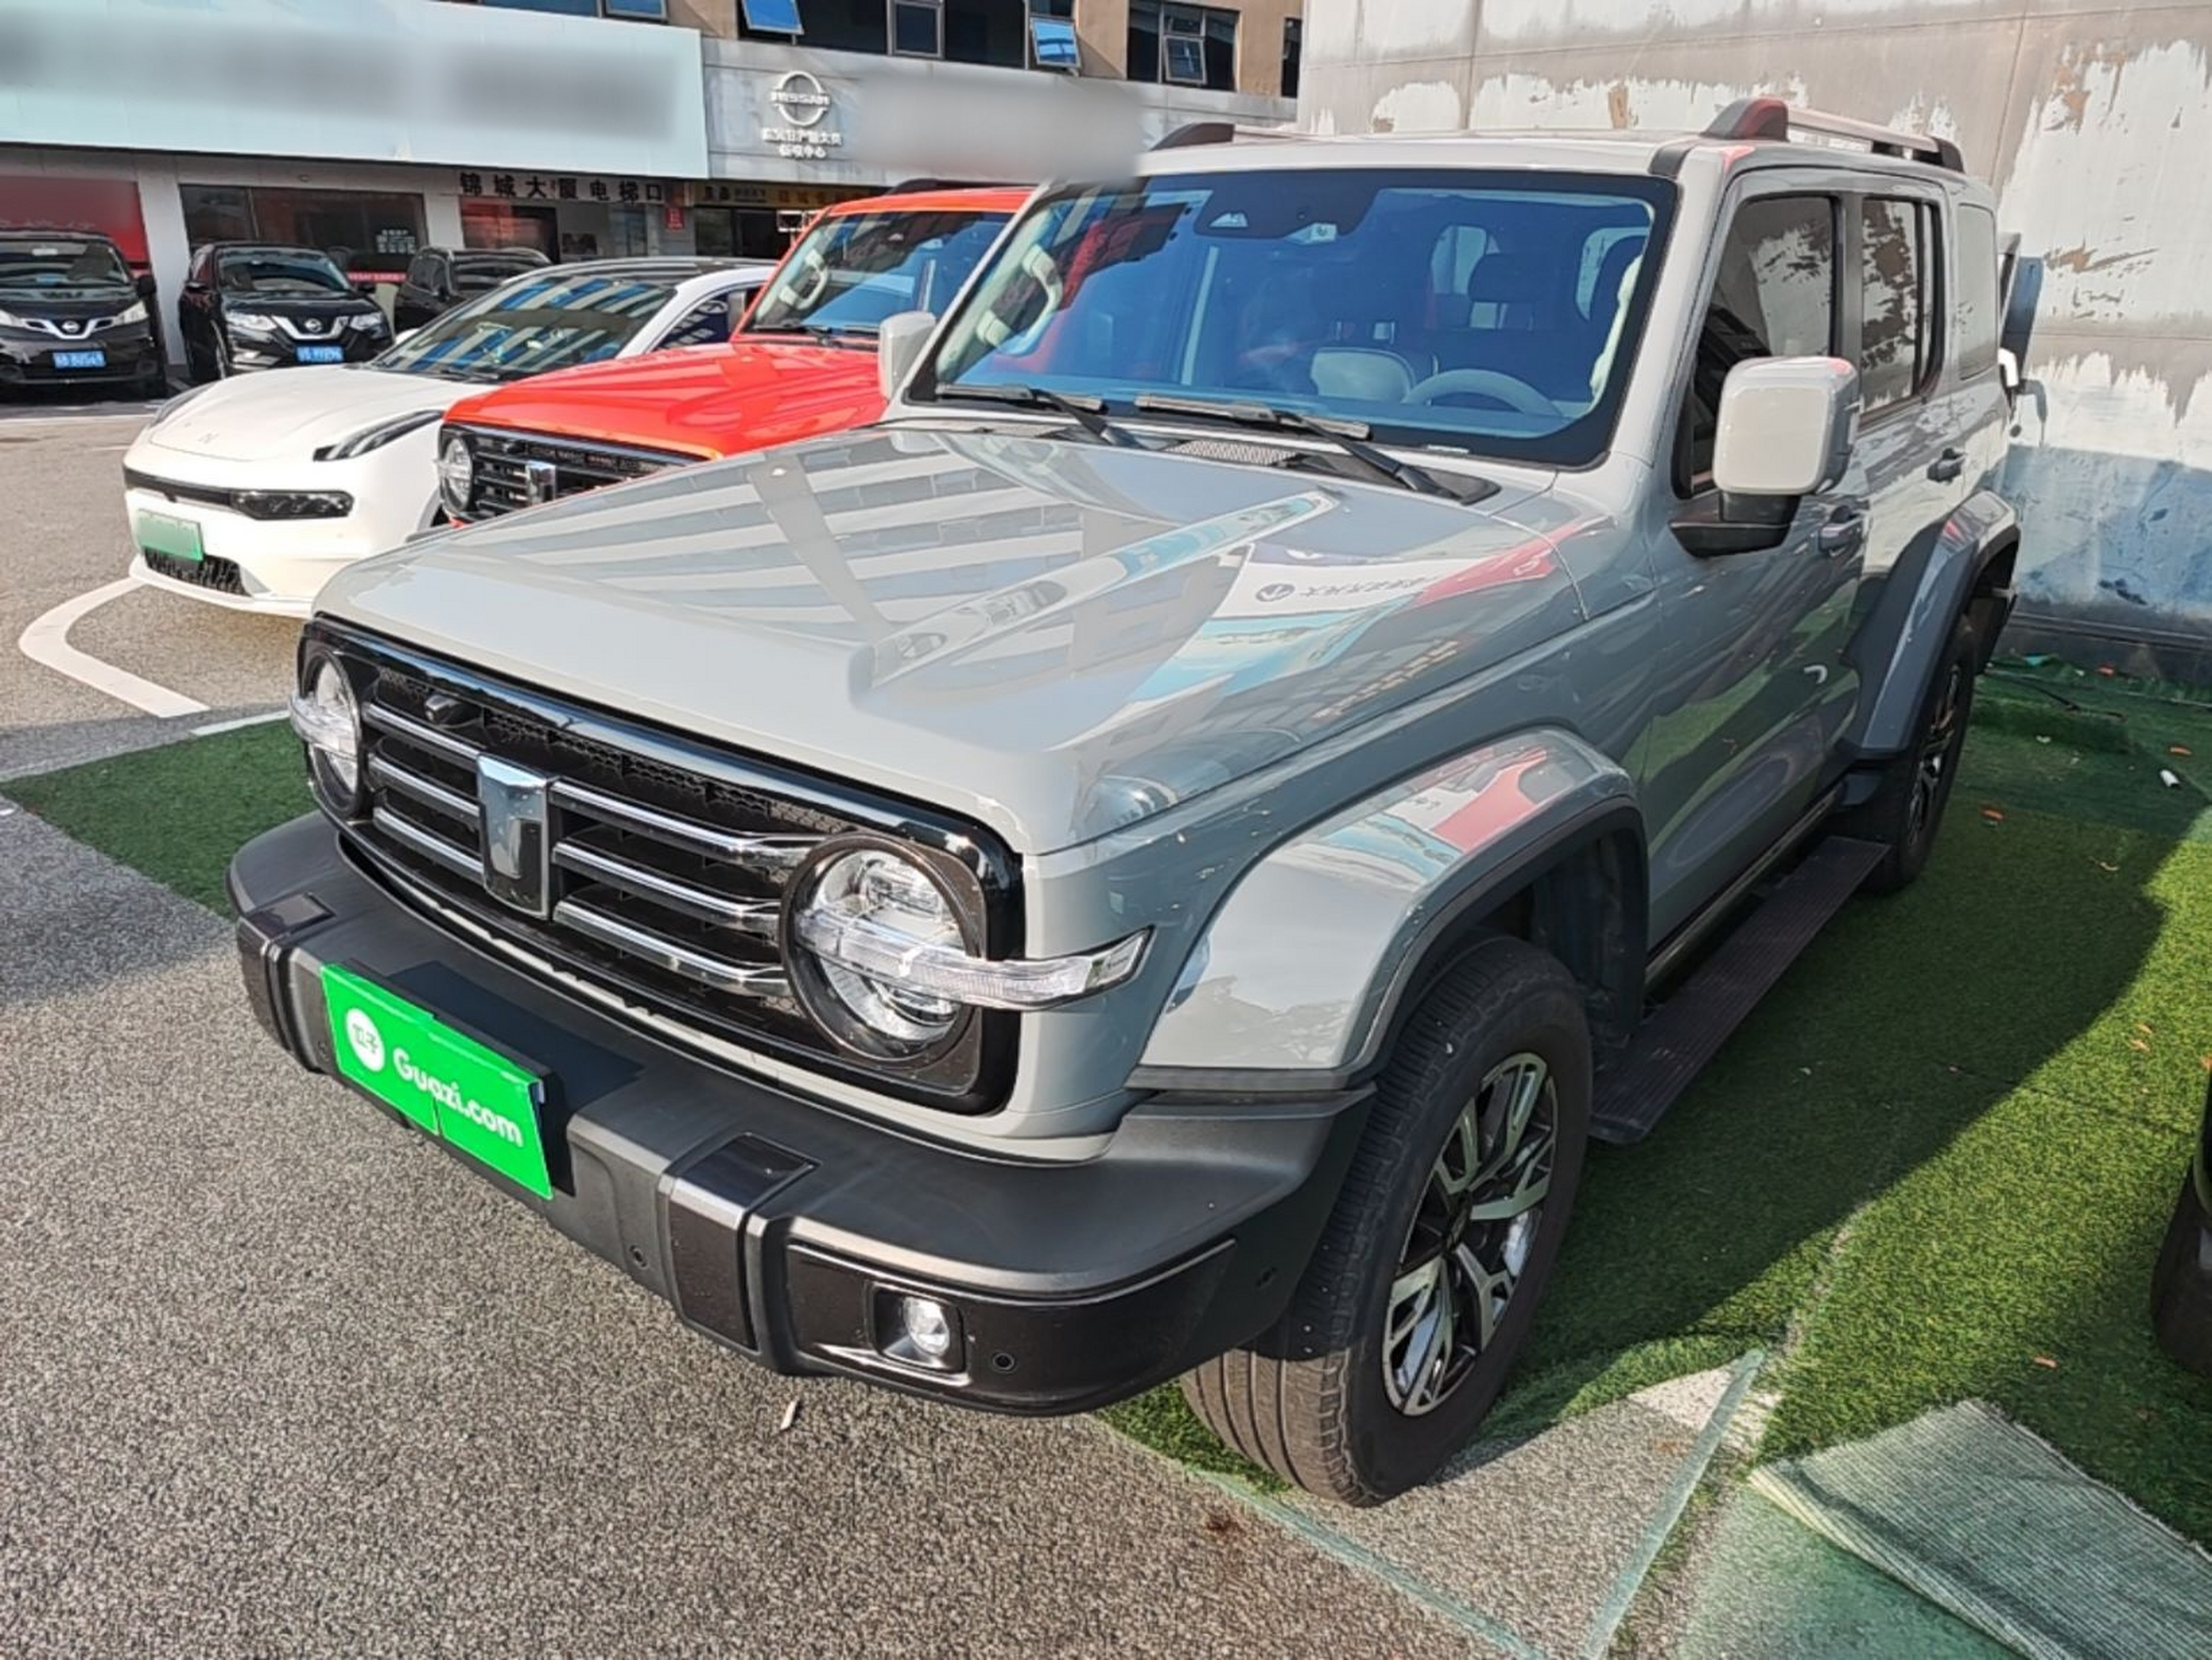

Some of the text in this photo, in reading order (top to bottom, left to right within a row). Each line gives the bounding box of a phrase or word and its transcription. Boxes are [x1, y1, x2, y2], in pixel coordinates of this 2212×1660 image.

[460, 172, 663, 203] 锦城大厦电梯口
[393, 1048, 524, 1147] Guazi.com
